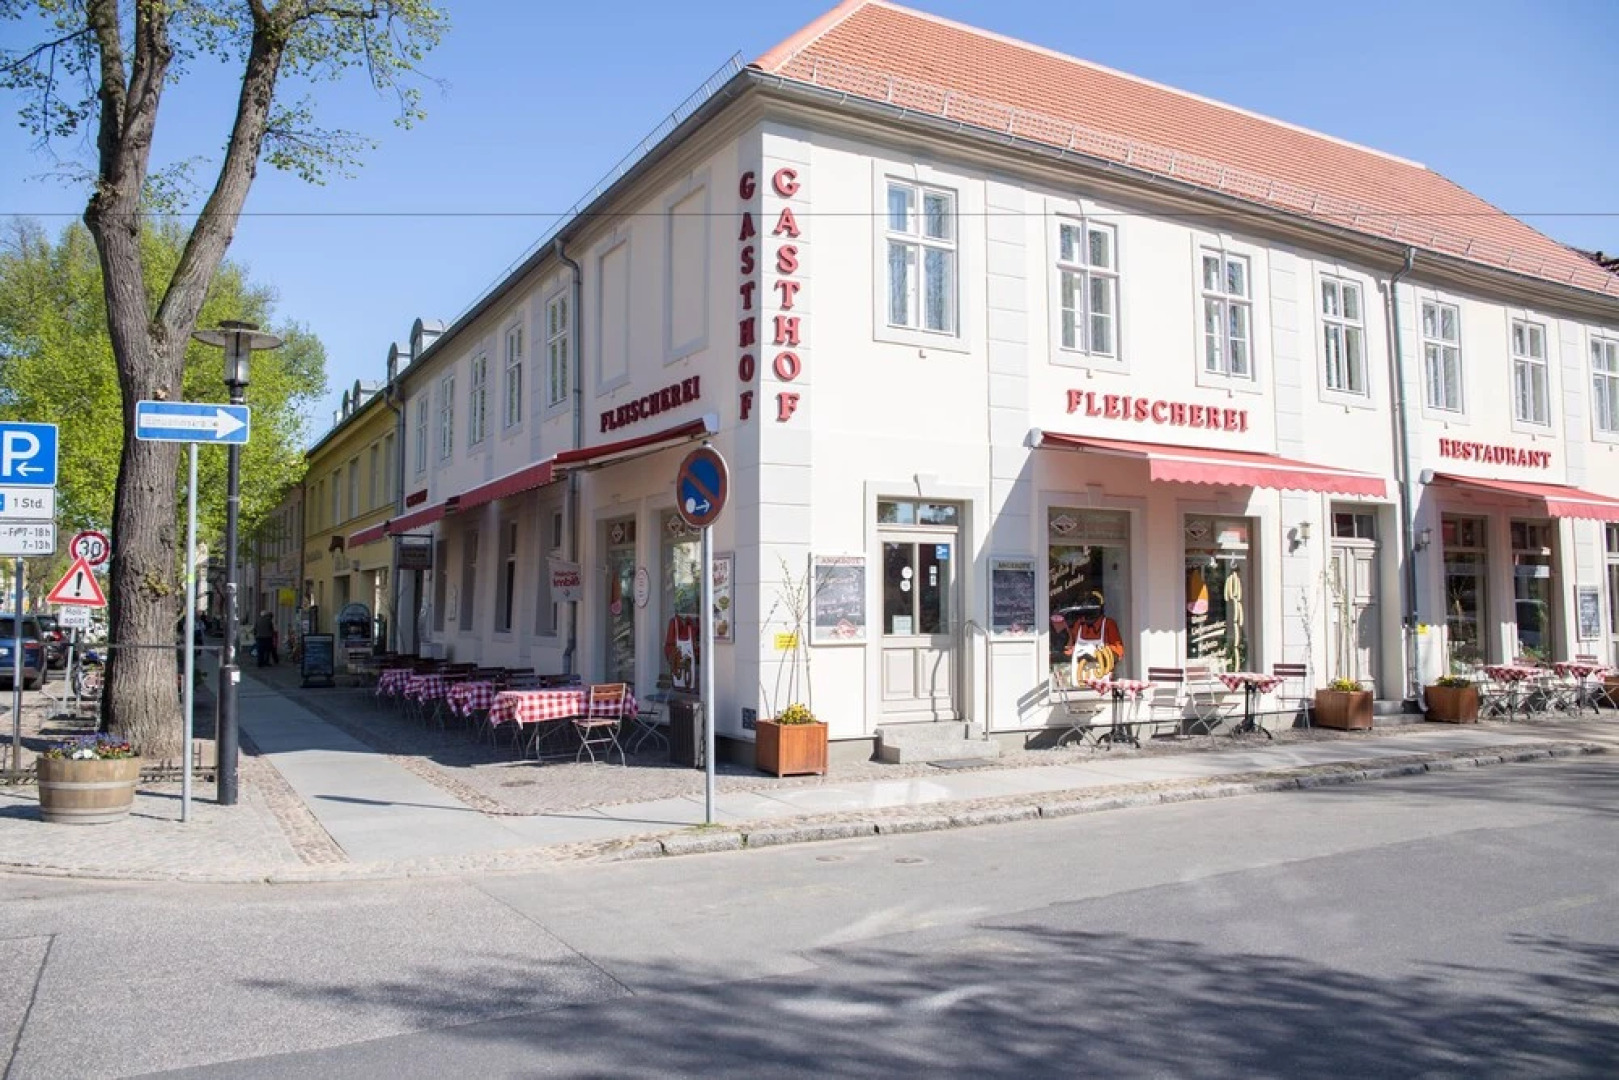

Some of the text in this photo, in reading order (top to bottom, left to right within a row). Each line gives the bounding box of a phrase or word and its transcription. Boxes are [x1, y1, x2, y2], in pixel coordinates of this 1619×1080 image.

[738, 171, 756, 421] GASTHOF
[772, 167, 801, 422] GASTHOF
[600, 375, 700, 433] FLEISCHEREI
[1066, 389, 1248, 432] FLEISCHEREI
[2, 430, 40, 476] P
[1439, 438, 1551, 468] RESTAURANT
[79, 540, 102, 558] 30
